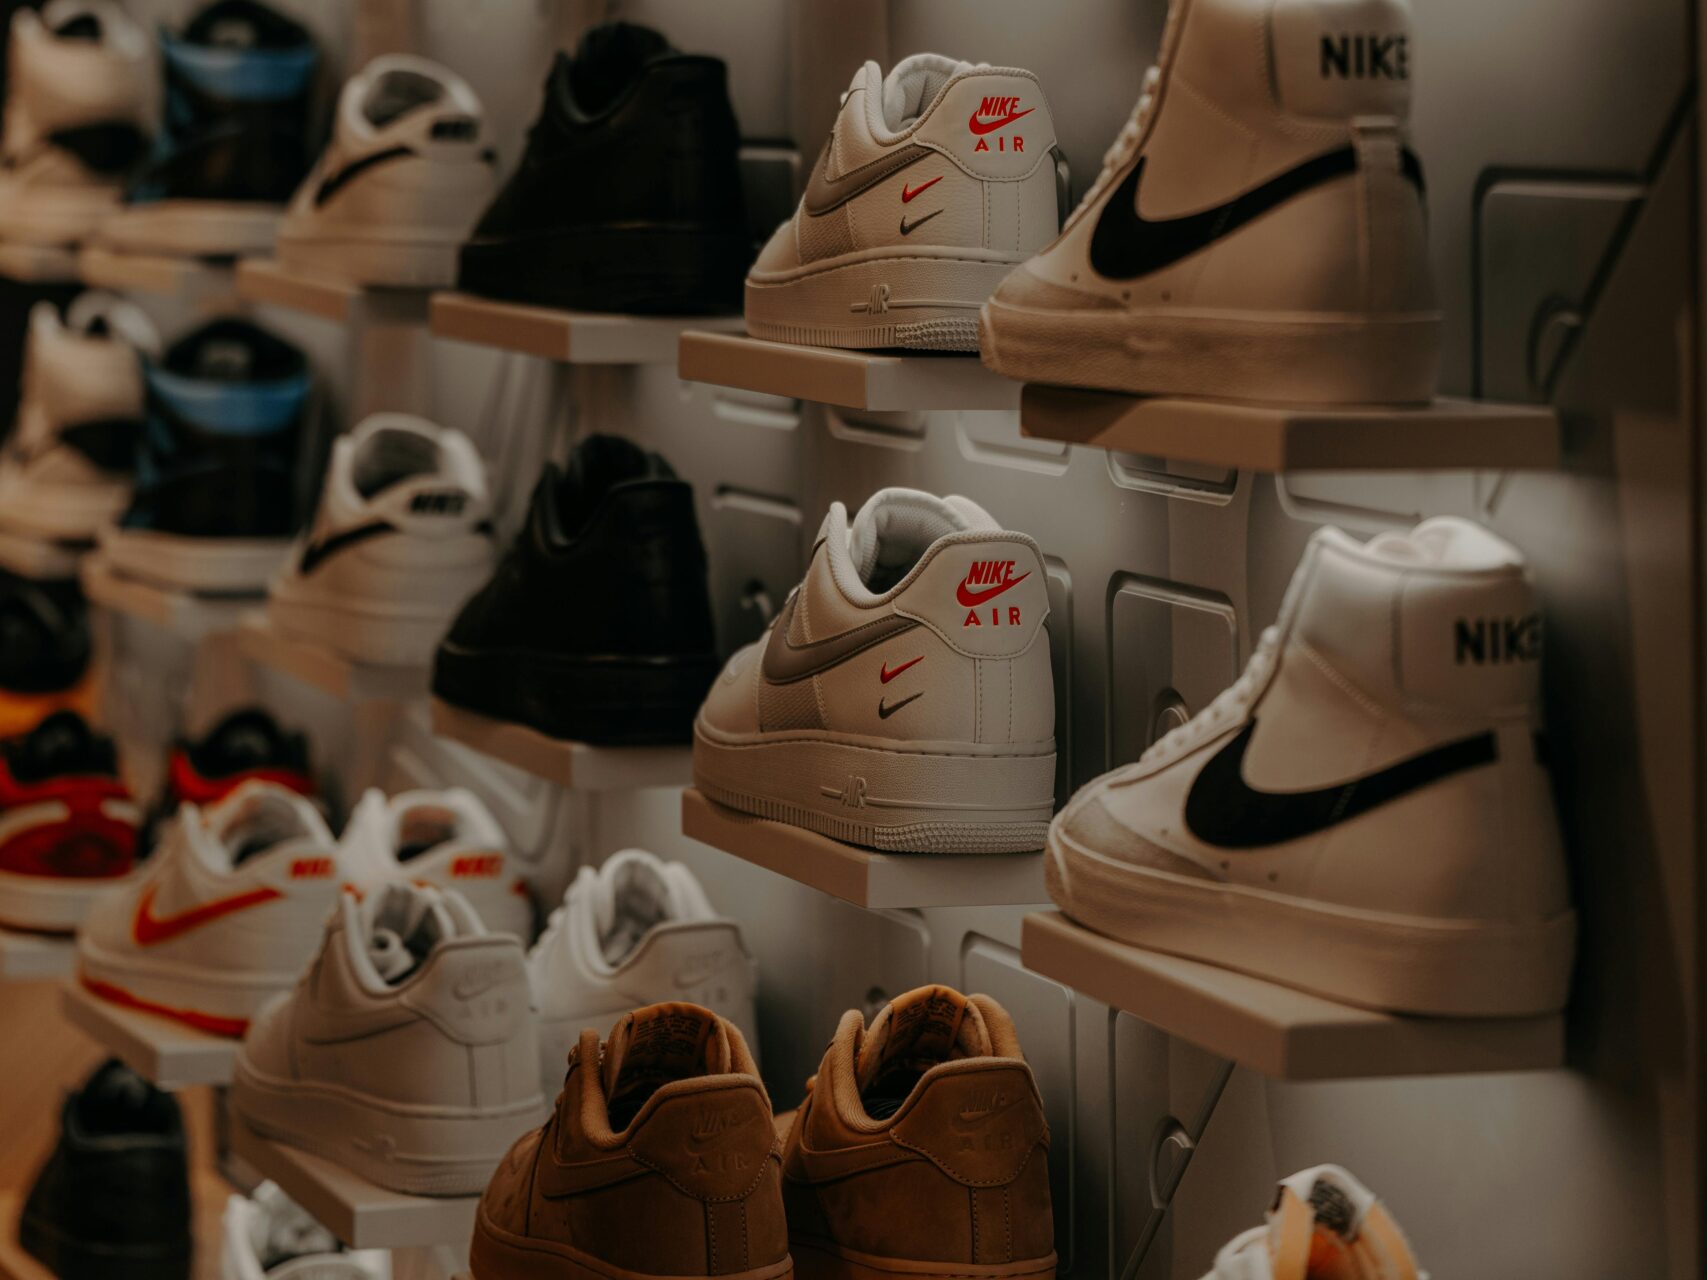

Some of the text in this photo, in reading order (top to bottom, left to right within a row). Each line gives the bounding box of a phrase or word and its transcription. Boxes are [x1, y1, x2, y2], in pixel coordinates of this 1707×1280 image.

[1320, 35, 1409, 80] NIKE
[978, 96, 1020, 117] NIKE
[974, 135, 1024, 152] AIR
[966, 560, 1016, 585] NIKE
[963, 607, 1022, 627] AIR
